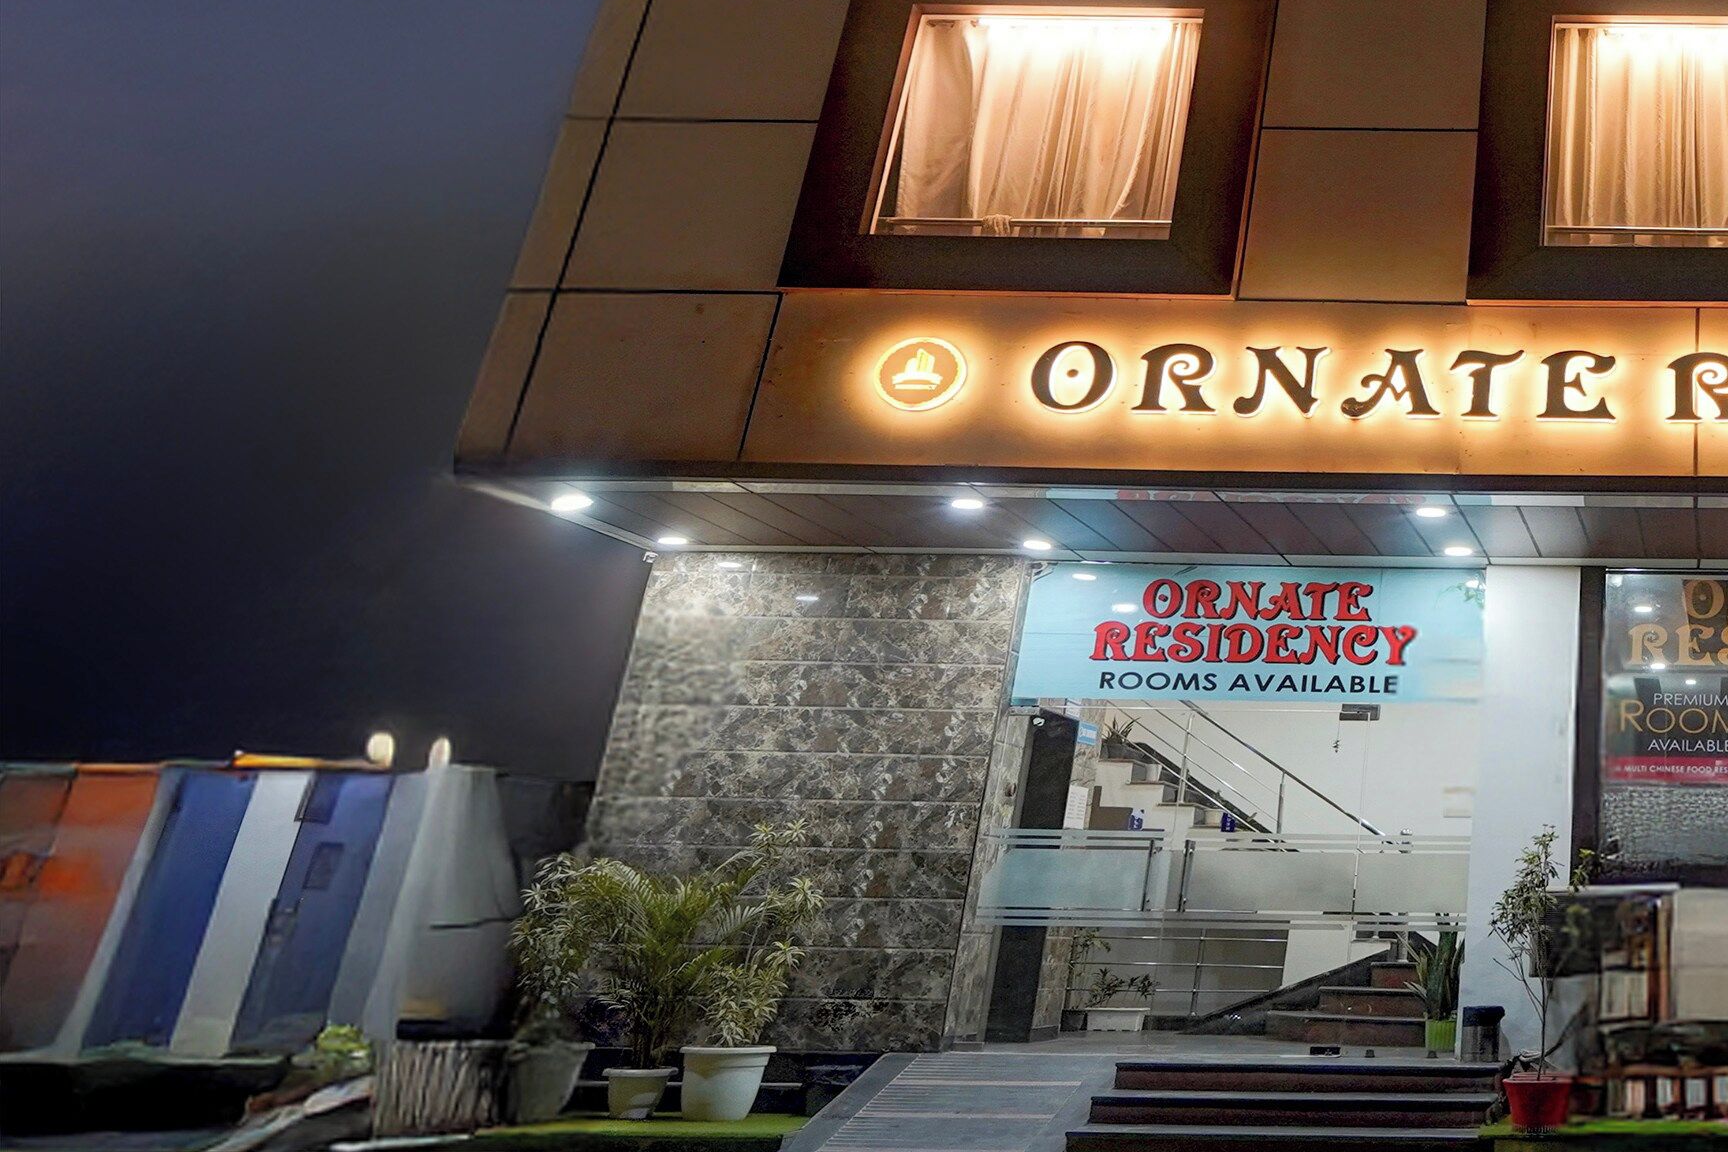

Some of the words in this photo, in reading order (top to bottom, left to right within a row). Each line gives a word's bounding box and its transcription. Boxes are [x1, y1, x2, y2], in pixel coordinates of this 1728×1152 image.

[1029, 339, 1617, 422] ORNATE
[1142, 578, 1375, 622] ORNATE
[1089, 621, 1418, 666] RESIDENCY
[1099, 671, 1218, 692] ROOMS
[1228, 671, 1400, 695] AVAILABLE
[1653, 692, 1728, 707] PREMIUM
[1649, 765, 1685, 773] CHINESE
[1686, 765, 1713, 774] FOOD
